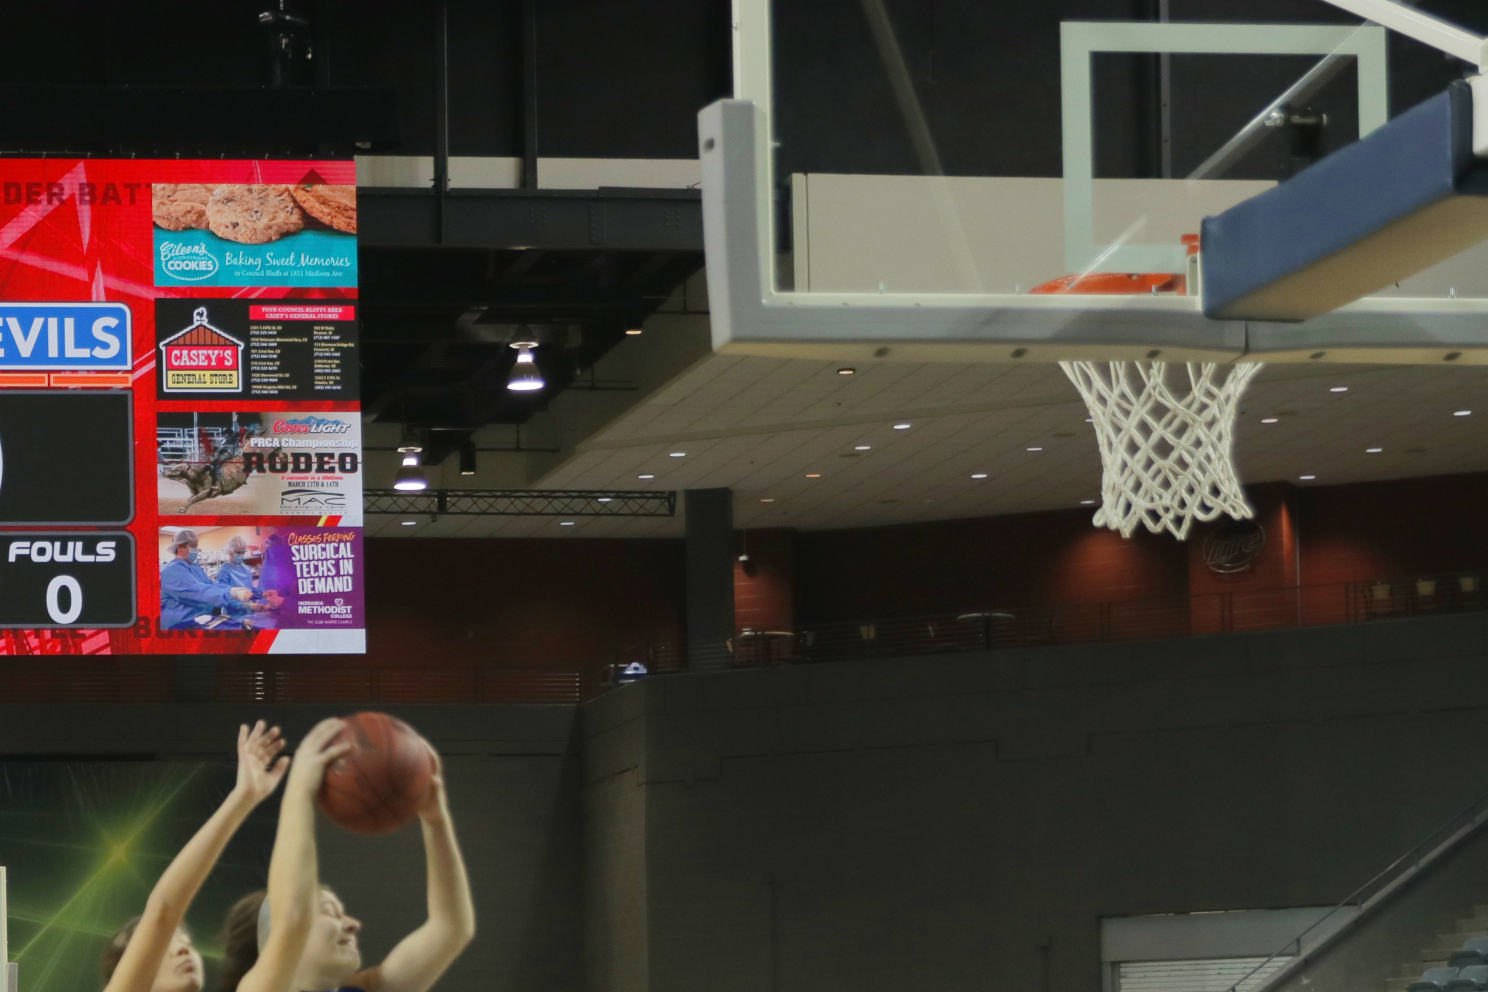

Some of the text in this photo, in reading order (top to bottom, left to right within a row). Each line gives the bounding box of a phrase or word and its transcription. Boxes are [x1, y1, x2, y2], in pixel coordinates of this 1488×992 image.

[168, 261, 213, 271] COOKIES
[225, 251, 351, 271] Baking Sweet Memories
[171, 350, 233, 366] CASEY'S
[171, 373, 233, 385] GENERAL STORE
[273, 419, 351, 434] Coors LIGHT
[250, 438, 358, 449] PRCA Championship
[242, 452, 358, 473] RODEO
[281, 497, 346, 506] MAC
[9, 541, 115, 563] FOULS
[291, 542, 354, 561] SURGICAL
[293, 559, 353, 578] TECHS IN
[298, 576, 353, 595] DEMAND
[46, 575, 82, 625] 0
[298, 606, 352, 614] METHODIST
